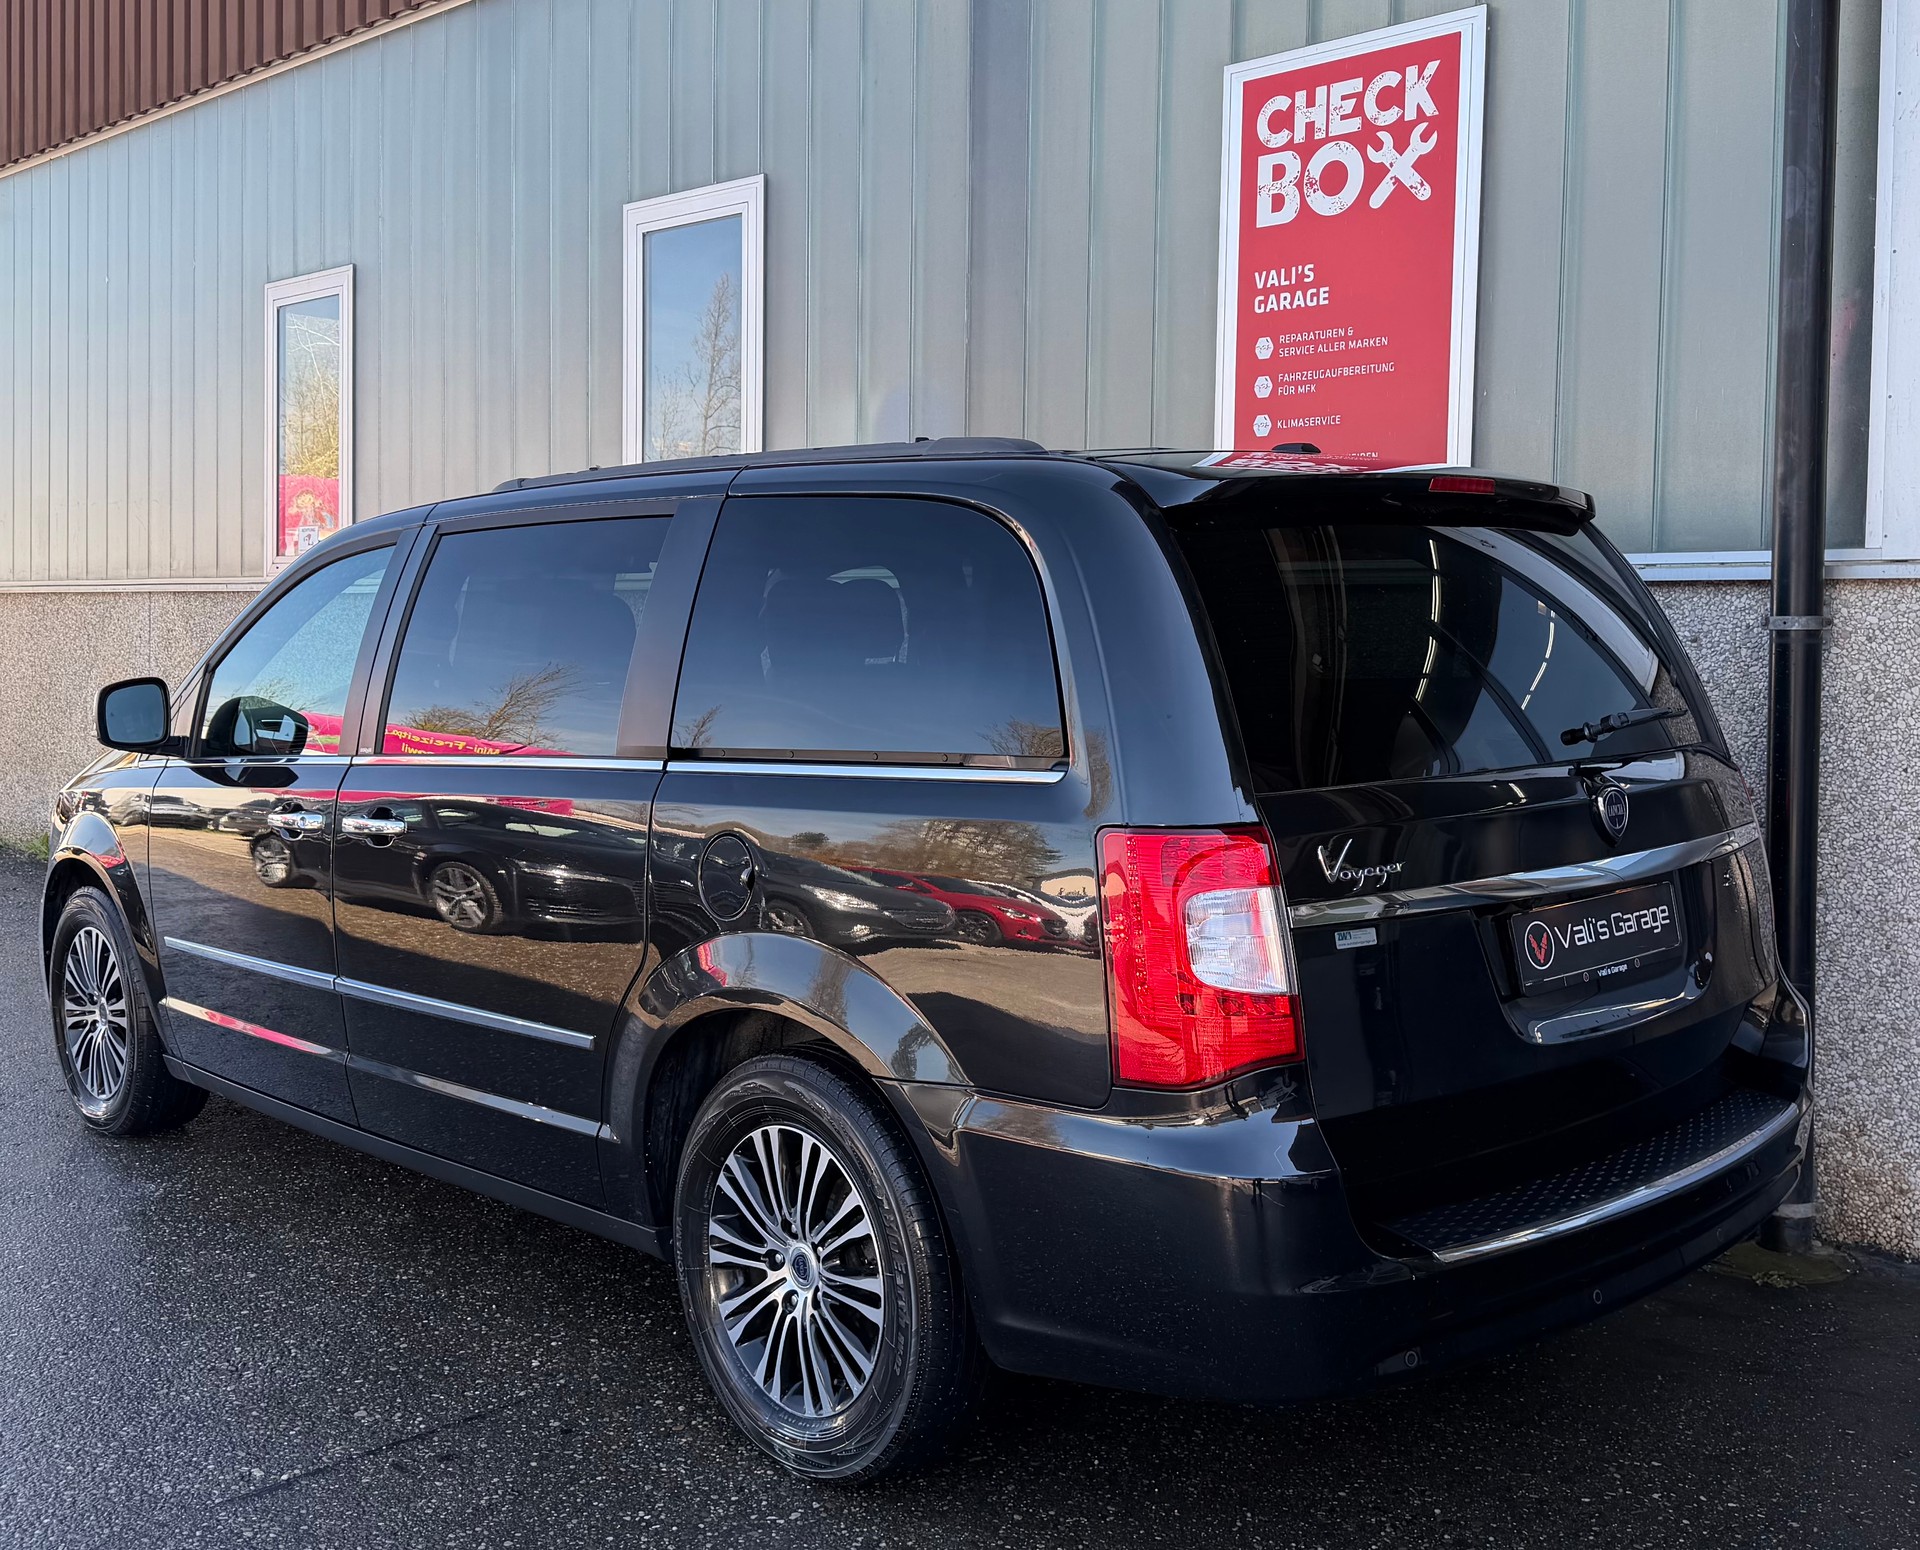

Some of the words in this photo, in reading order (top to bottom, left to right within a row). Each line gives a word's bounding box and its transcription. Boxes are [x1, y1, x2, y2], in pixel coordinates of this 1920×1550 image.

[1256, 59, 1441, 148] CHECK
[1254, 263, 1315, 290] VALI'S
[1254, 286, 1330, 314] GARAGE
[1279, 327, 1345, 344] REPARATUREN
[1347, 326, 1354, 336] &
[1279, 344, 1315, 358] SERVICE
[1317, 341, 1346, 353] ALLER
[1348, 336, 1388, 350] MARKEN
[1278, 362, 1395, 383] FAHRZEUGAUFBEREITUNG
[1277, 384, 1296, 396] FÜR
[1297, 383, 1316, 394] MFK
[1277, 415, 1341, 429] KLIMASERVICE
[1317, 838, 1406, 892] Voyager
[1554, 916, 1610, 949] Vali's
[1610, 904, 1671, 937] Garage
[1611, 963, 1628, 974] Garage
